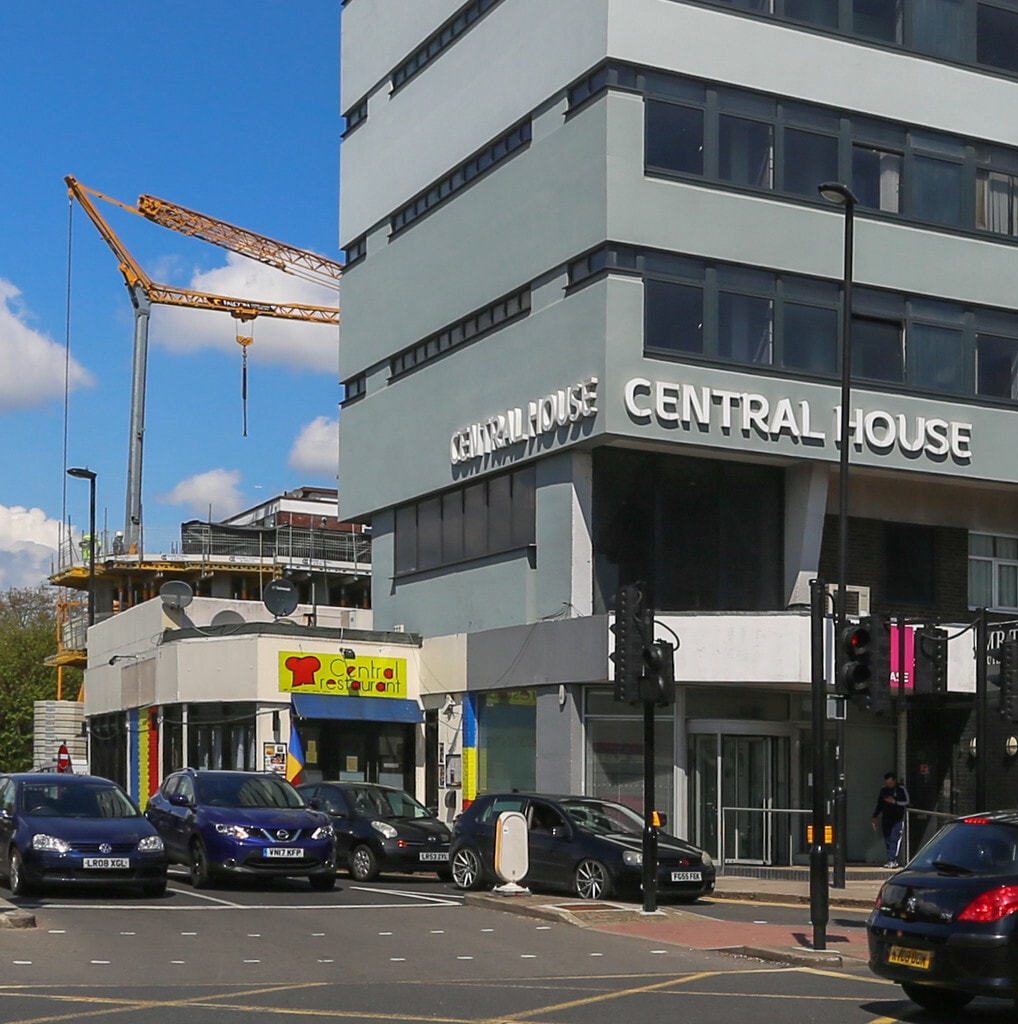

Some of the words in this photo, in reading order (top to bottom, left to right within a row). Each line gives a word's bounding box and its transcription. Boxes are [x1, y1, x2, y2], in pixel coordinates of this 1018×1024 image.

[451, 407, 528, 465] CENTRAL
[528, 377, 598, 437] HOUSE
[624, 378, 826, 440] CENTRAL
[833, 404, 973, 458] HOUSE
[330, 658, 398, 680] Central
[320, 677, 401, 694] restaurant
[87, 858, 109, 868] LR08
[110, 858, 126, 868] XGL
